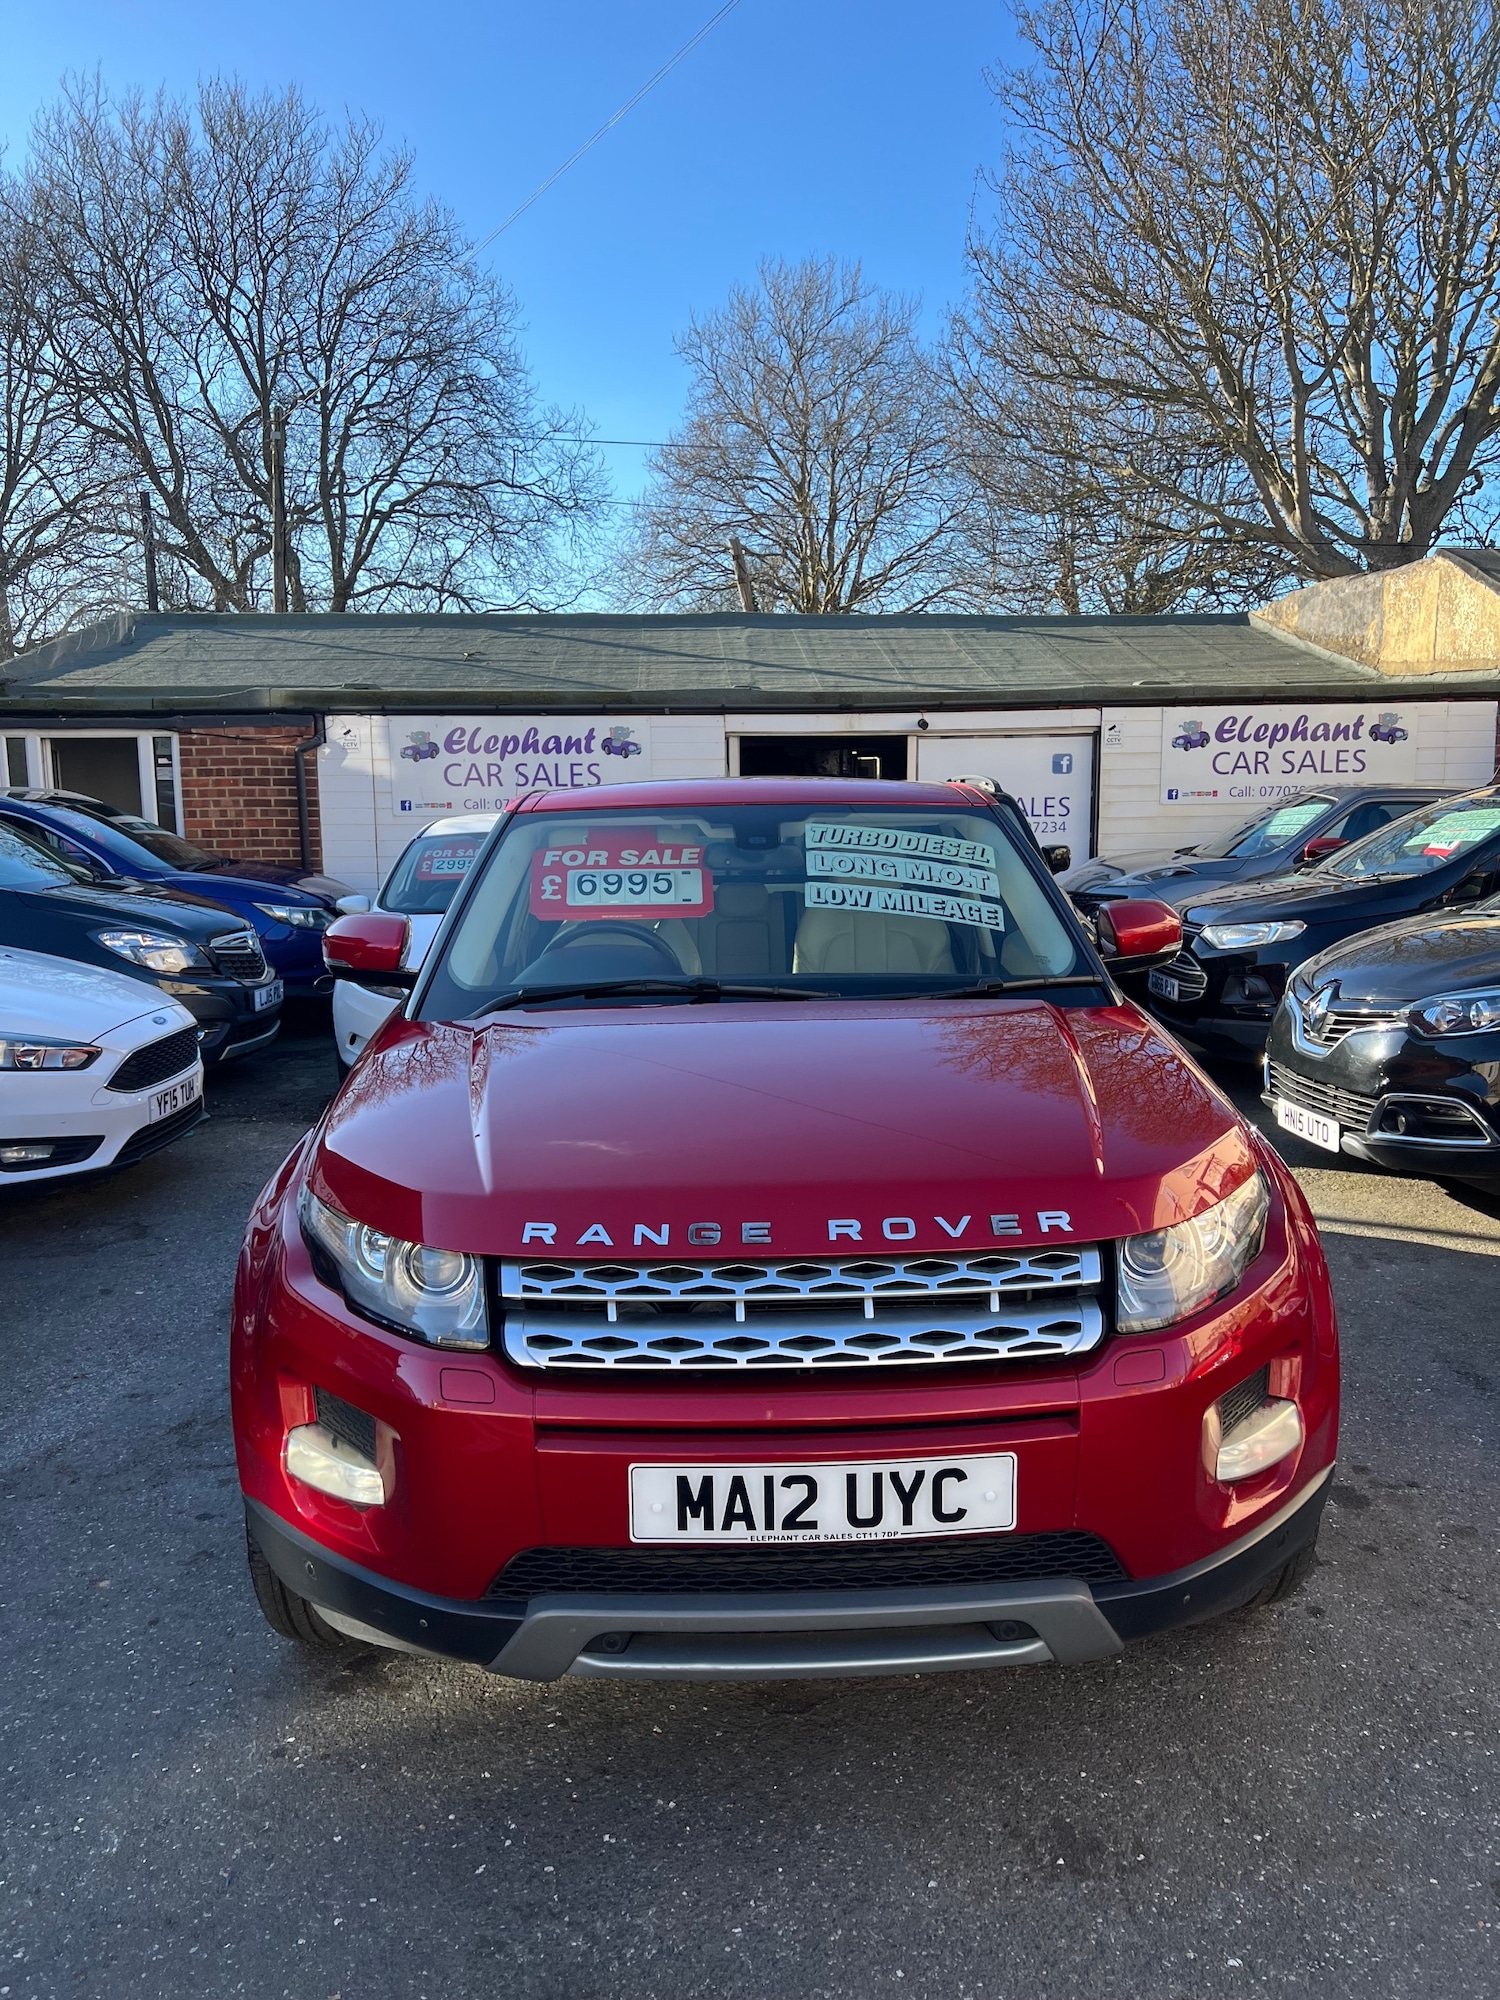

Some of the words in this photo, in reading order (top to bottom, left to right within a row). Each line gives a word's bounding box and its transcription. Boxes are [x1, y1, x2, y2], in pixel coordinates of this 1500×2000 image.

[443, 726, 596, 761] Elephant
[1215, 714, 1365, 749] Elephant
[443, 763, 504, 787] CAR
[515, 762, 602, 787] SALES
[1212, 751, 1270, 775] CAR
[1281, 749, 1367, 774] SALES
[463, 798, 490, 810] Call:
[1229, 786, 1255, 798] Call:
[1016, 796, 1071, 818] ALES
[1028, 820, 1068, 834] 7234
[423, 849, 453, 858] FOR
[455, 848, 481, 857] SA
[542, 850, 609, 867] FOR
[618, 848, 701, 866] SALE
[810, 826, 899, 848] TURBO
[899, 833, 991, 864] DIESEL
[576, 872, 674, 897] 6995
[814, 853, 898, 878] LONG
[905, 861, 990, 891] M.O.T
[809, 885, 874, 908] LOW
[877, 890, 1001, 927] MILEAGE
[156, 1087, 178, 1116] YF15
[1284, 1104, 1304, 1132] HN15
[1307, 1115, 1329, 1143] UTO
[521, 1222, 772, 1246] RANGE
[827, 1210, 1075, 1241] ROVER
[676, 1474, 819, 1531] MA12
[845, 1467, 968, 1529] UYC
[750, 1534, 799, 1542] ELEPHANT
[823, 1532, 853, 1540] SALES
[855, 1531, 879, 1539] CT11
[881, 1530, 899, 1538] 7DP
